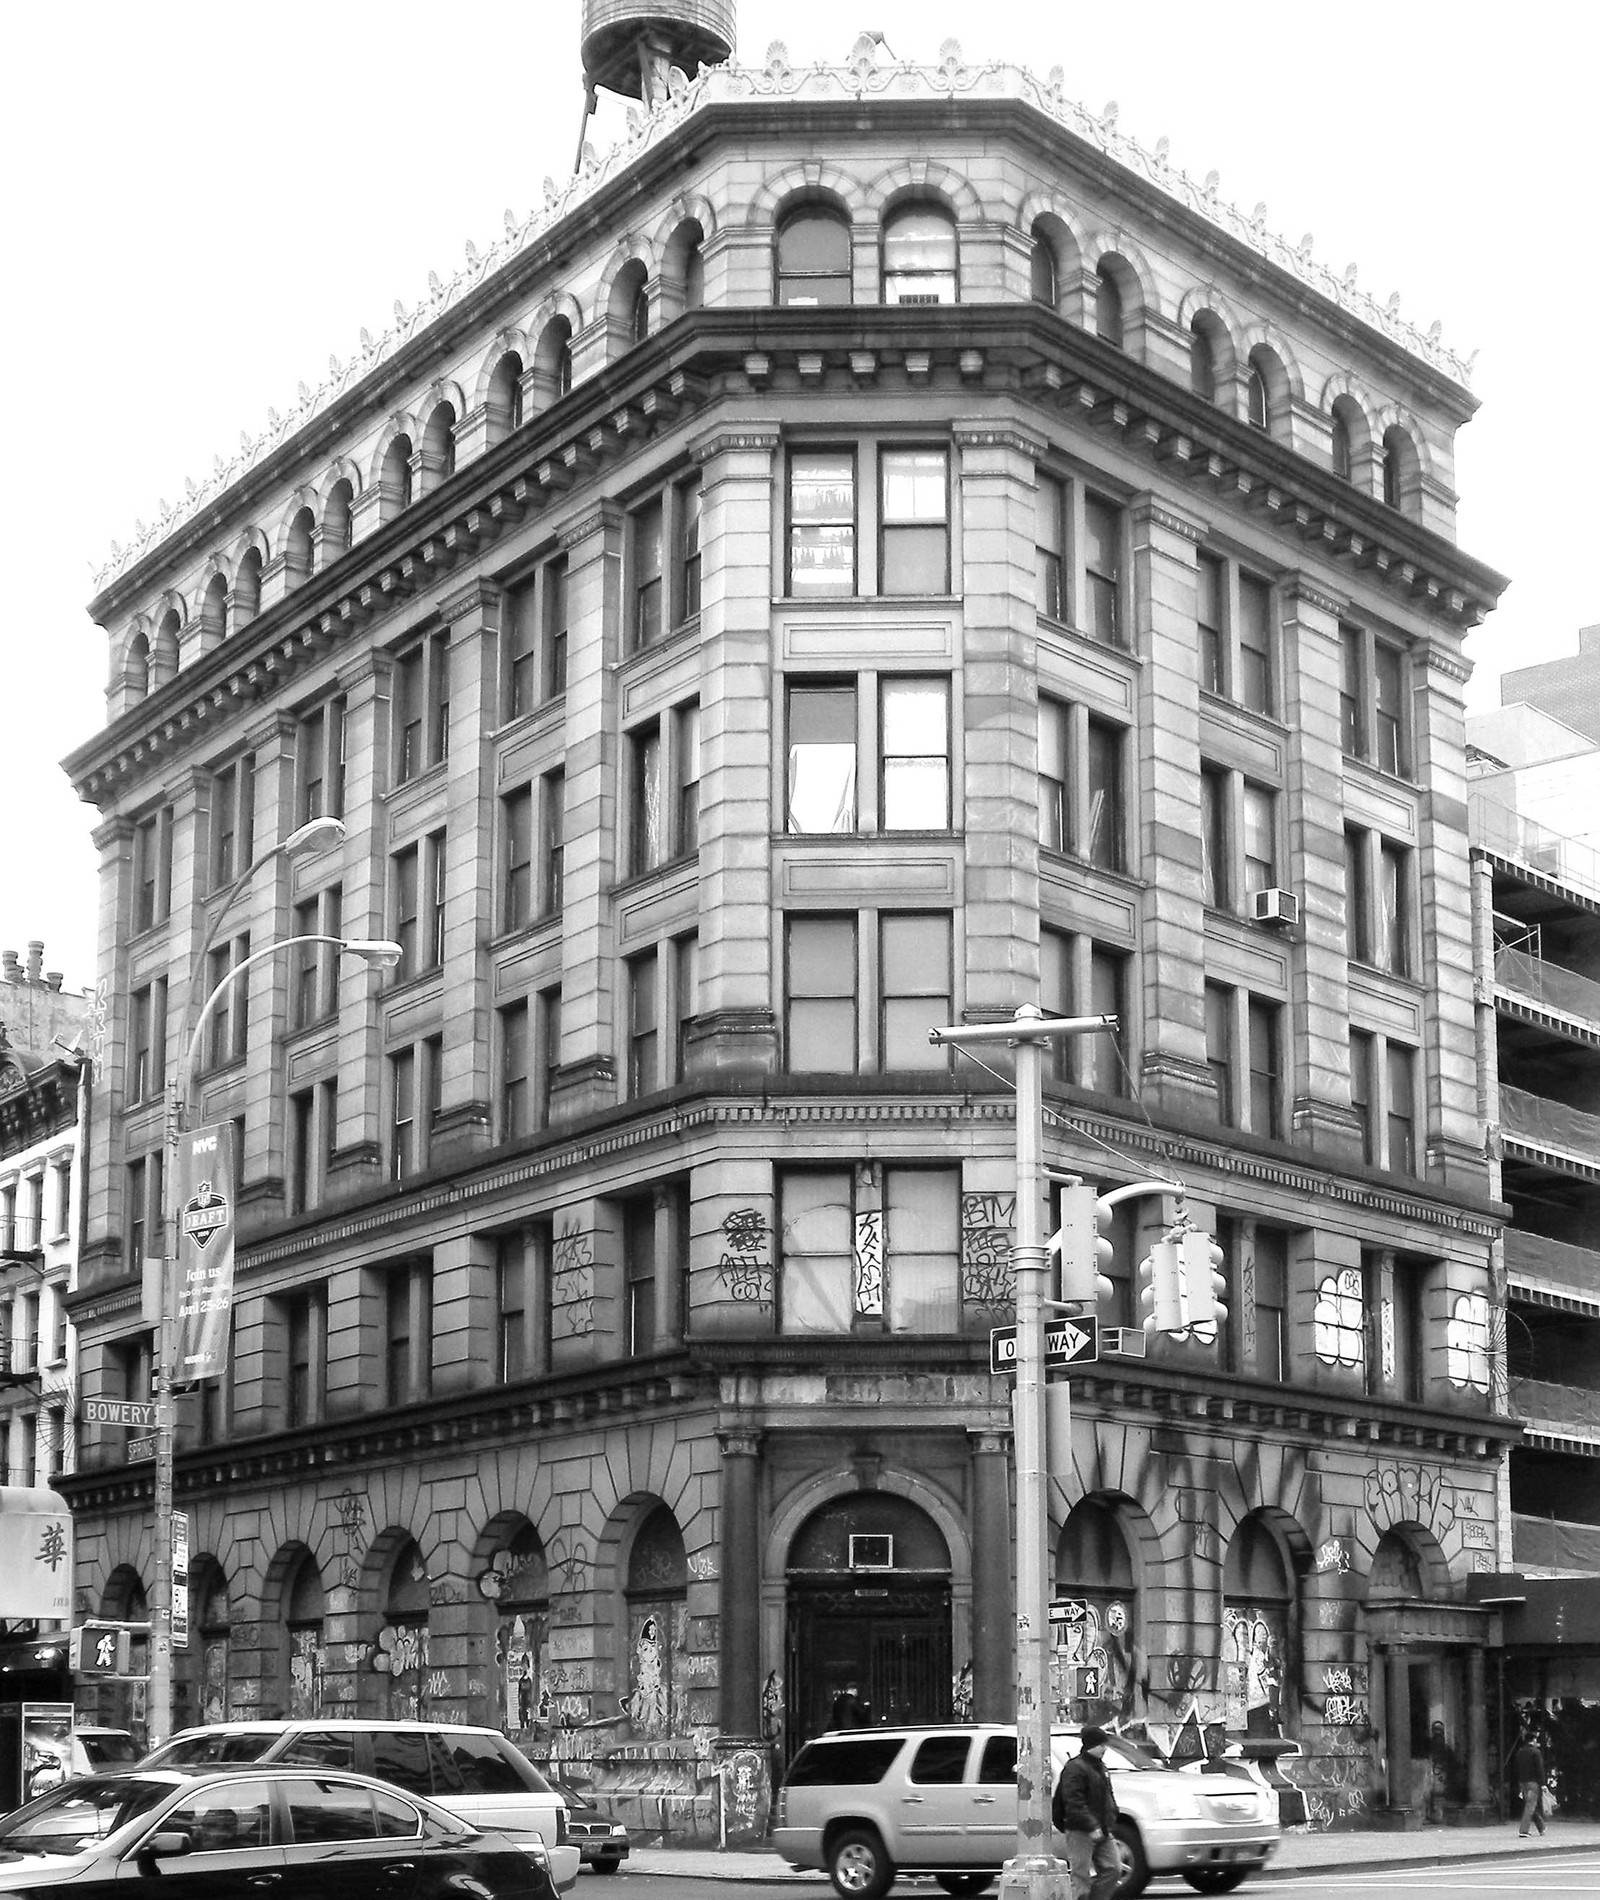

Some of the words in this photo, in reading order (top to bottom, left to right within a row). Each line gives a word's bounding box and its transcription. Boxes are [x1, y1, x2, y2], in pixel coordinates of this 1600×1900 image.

[192, 1136, 217, 1155] NYC
[186, 1268, 207, 1282] Join
[208, 1267, 222, 1279] us
[1048, 1333, 1080, 1352] WAY
[87, 1402, 151, 1424] BOWERY
[1064, 1607, 1080, 1617] WAY
